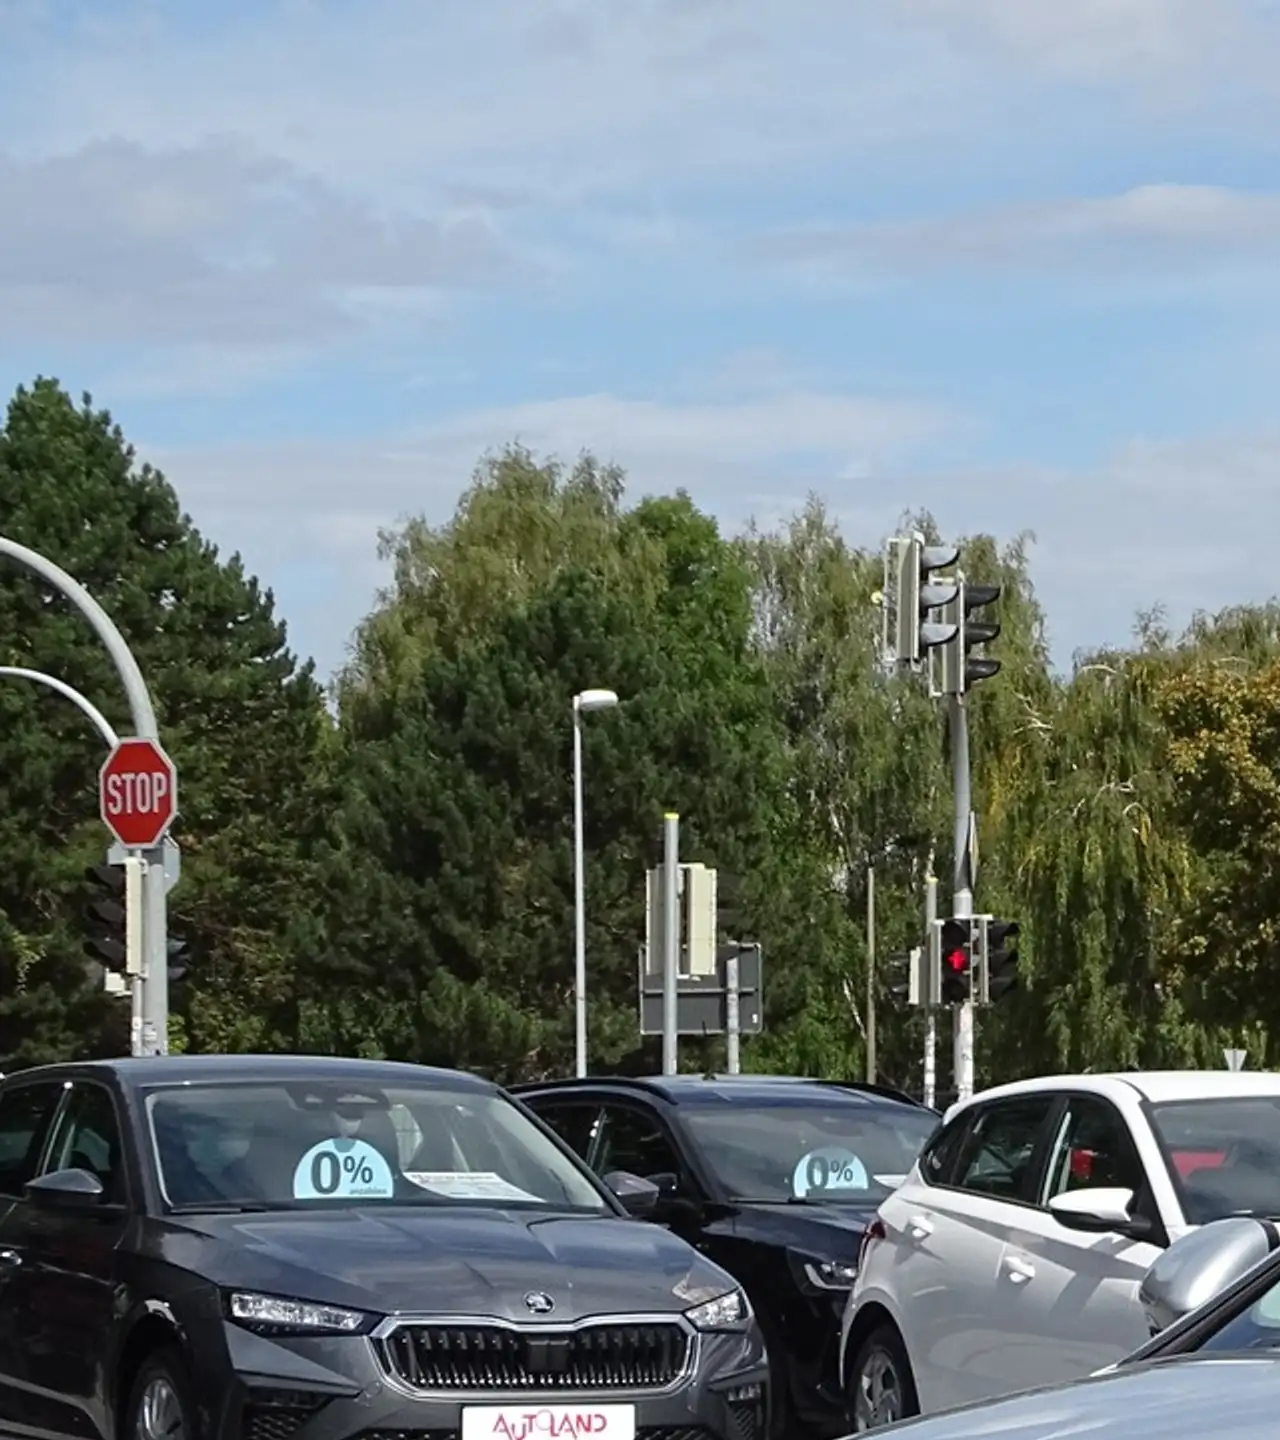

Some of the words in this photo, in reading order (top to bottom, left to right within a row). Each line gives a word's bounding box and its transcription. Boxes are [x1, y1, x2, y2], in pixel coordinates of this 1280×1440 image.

[108, 772, 168, 815] STOP
[311, 1150, 373, 1195] 0%
[806, 1157, 853, 1189] 0%
